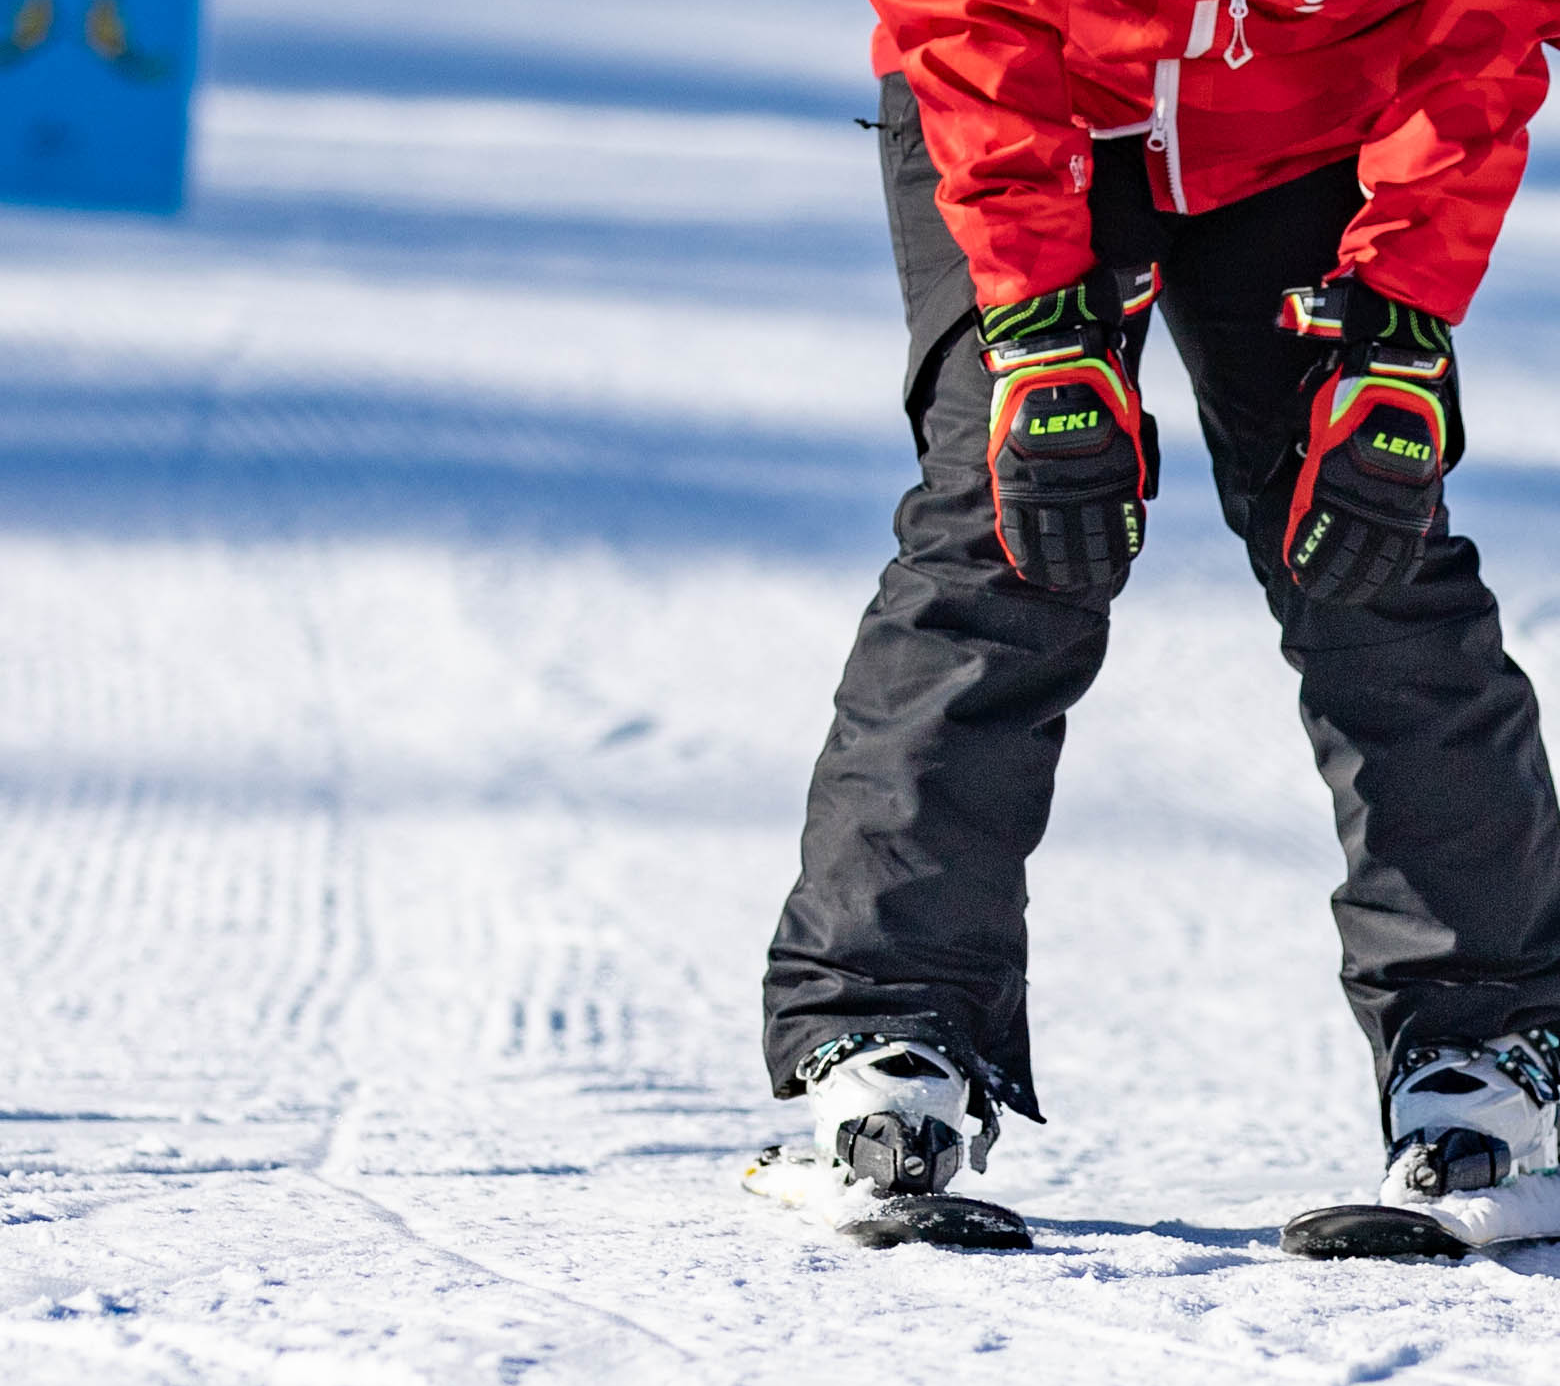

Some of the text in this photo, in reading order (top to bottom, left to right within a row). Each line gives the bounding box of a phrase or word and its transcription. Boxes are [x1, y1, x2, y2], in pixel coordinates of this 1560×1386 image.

[1029, 410, 1099, 436] LEKI
[1372, 431, 1431, 462] LEKI
[1122, 502, 1140, 554] LEKI
[1295, 511, 1332, 565] LEKI
